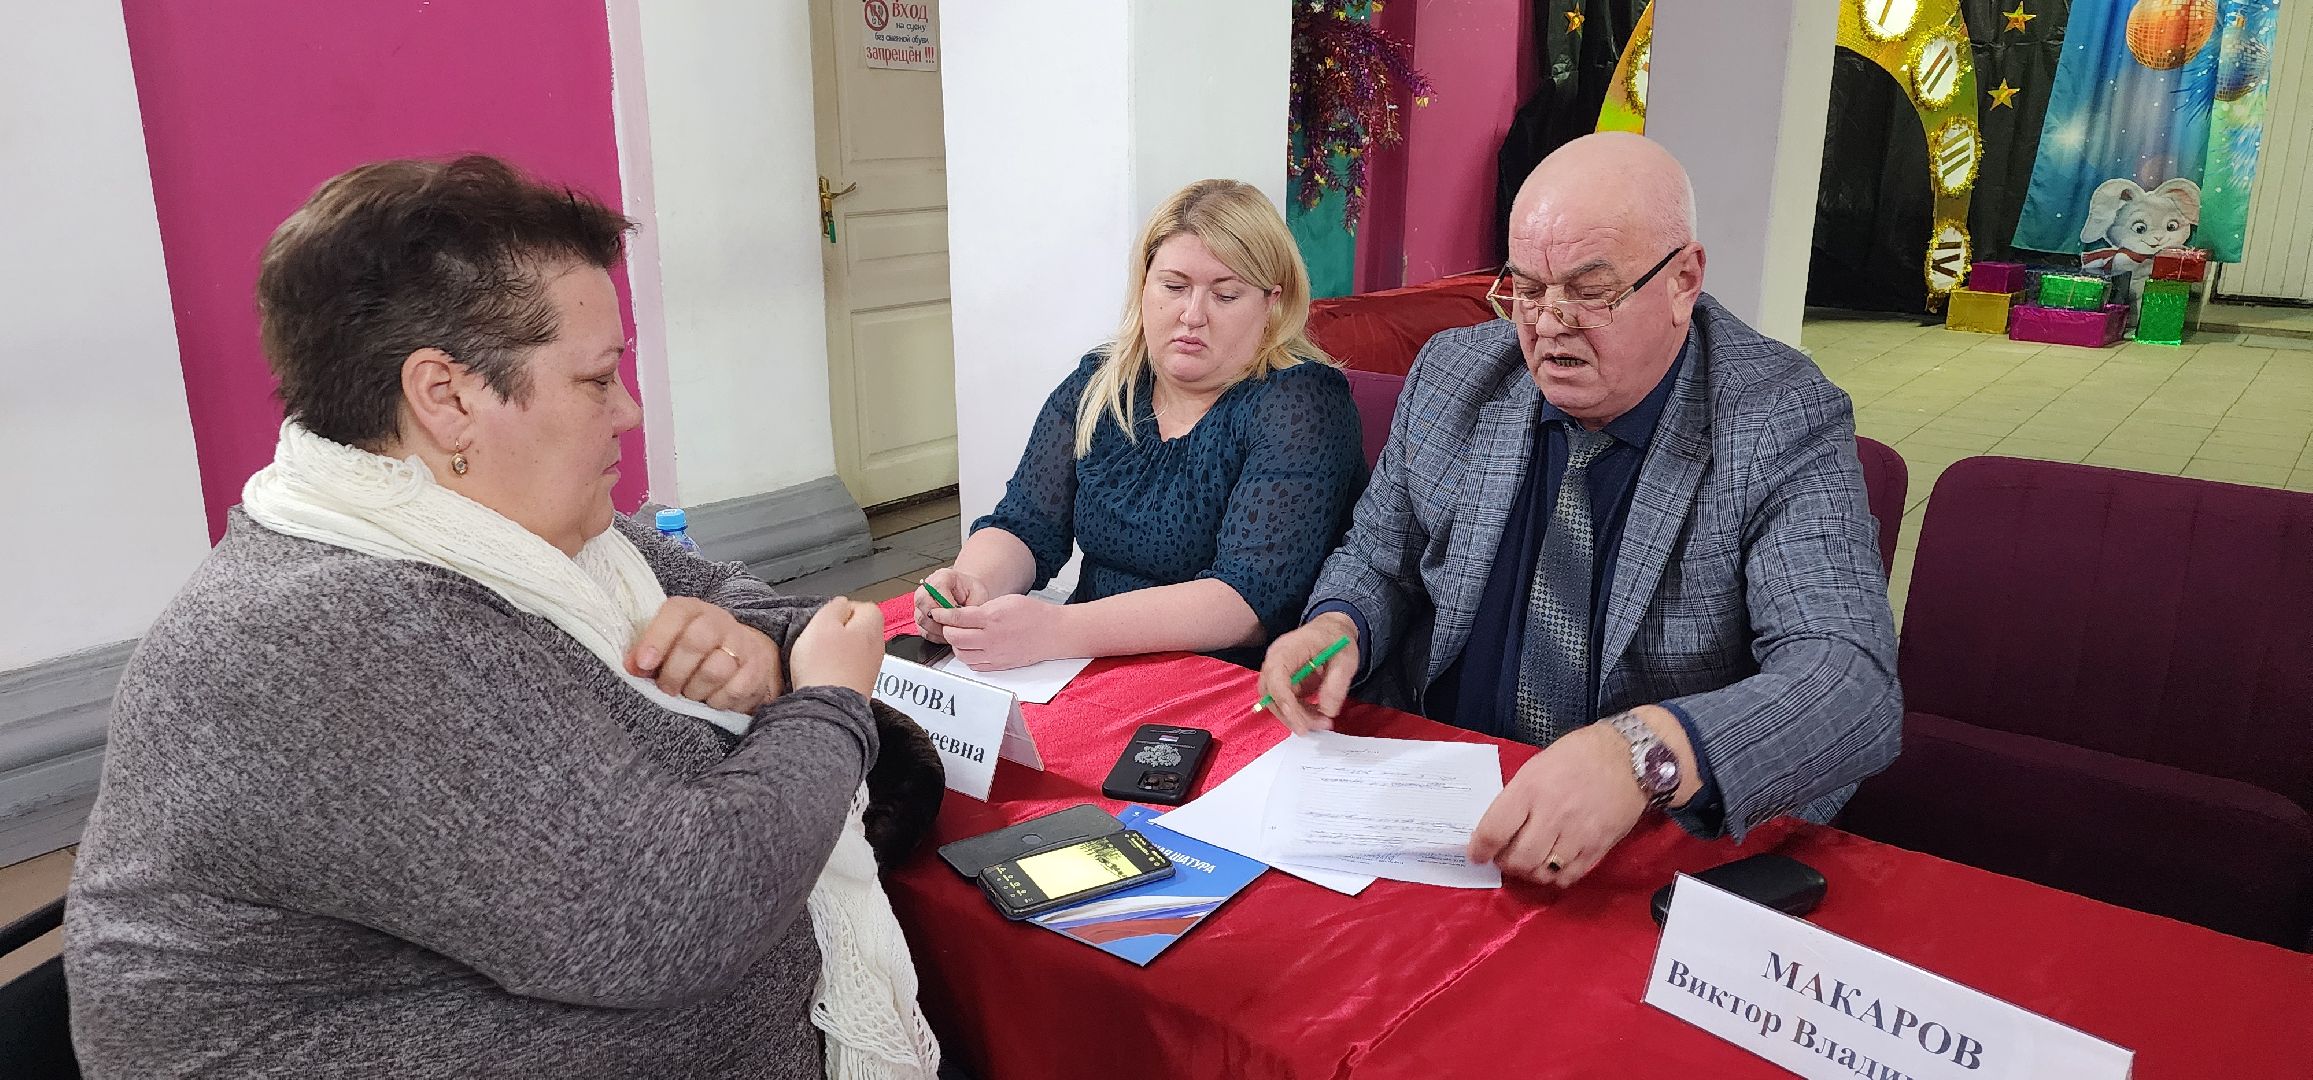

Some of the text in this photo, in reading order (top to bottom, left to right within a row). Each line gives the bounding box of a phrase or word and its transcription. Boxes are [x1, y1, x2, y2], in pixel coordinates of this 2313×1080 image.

[875, 32, 885, 41] без
[925, 46, 935, 63] !!!
[925, 729, 985, 764] еевна
[1665, 958, 1914, 1080] Виктор Влади
[1761, 950, 1983, 1070] МАКАРОВ
